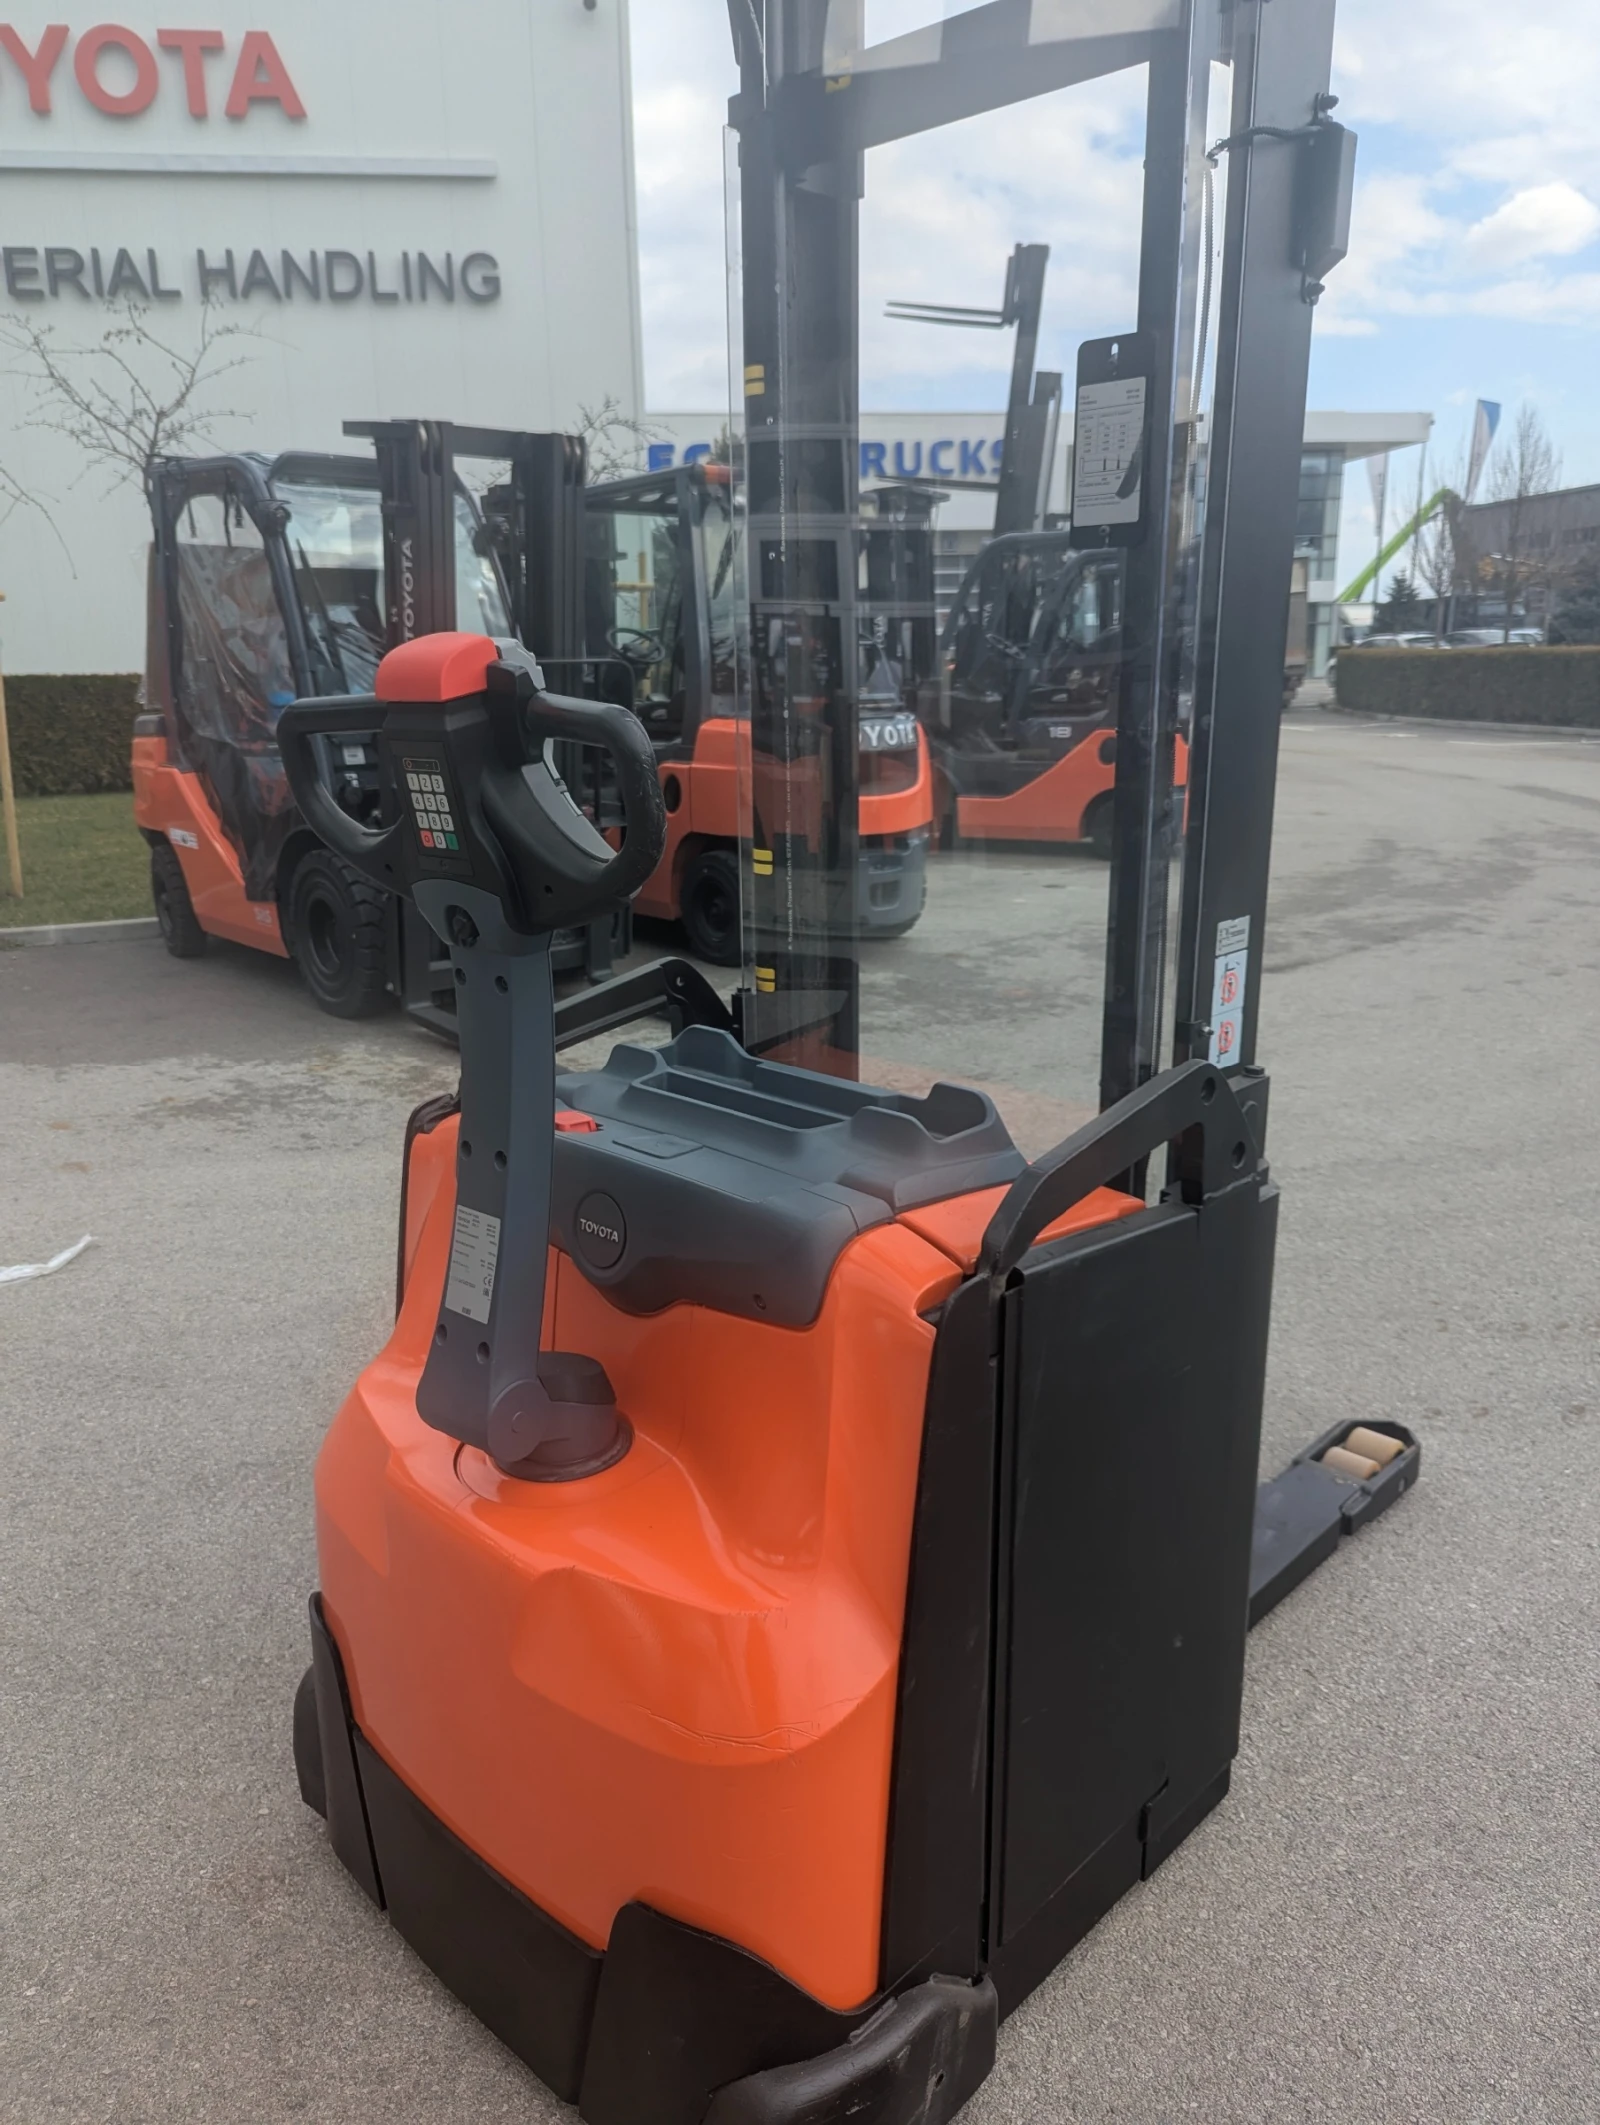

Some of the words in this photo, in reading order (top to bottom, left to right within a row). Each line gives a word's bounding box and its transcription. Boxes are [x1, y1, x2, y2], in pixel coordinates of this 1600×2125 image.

[197, 249, 500, 302] HANDLING
[402, 539, 414, 642] TOYOTA
[410, 777, 416, 787] 1
[423, 778, 429, 788] 2
[434, 779, 441, 789] 3
[415, 797, 421, 807] 4
[428, 798, 433, 808] 5
[439, 799, 446, 809] 6
[419, 815, 425, 825] 7
[431, 816, 438, 827] 8
[443, 817, 450, 827] 9
[580, 1218, 618, 1243] TOYOTA
